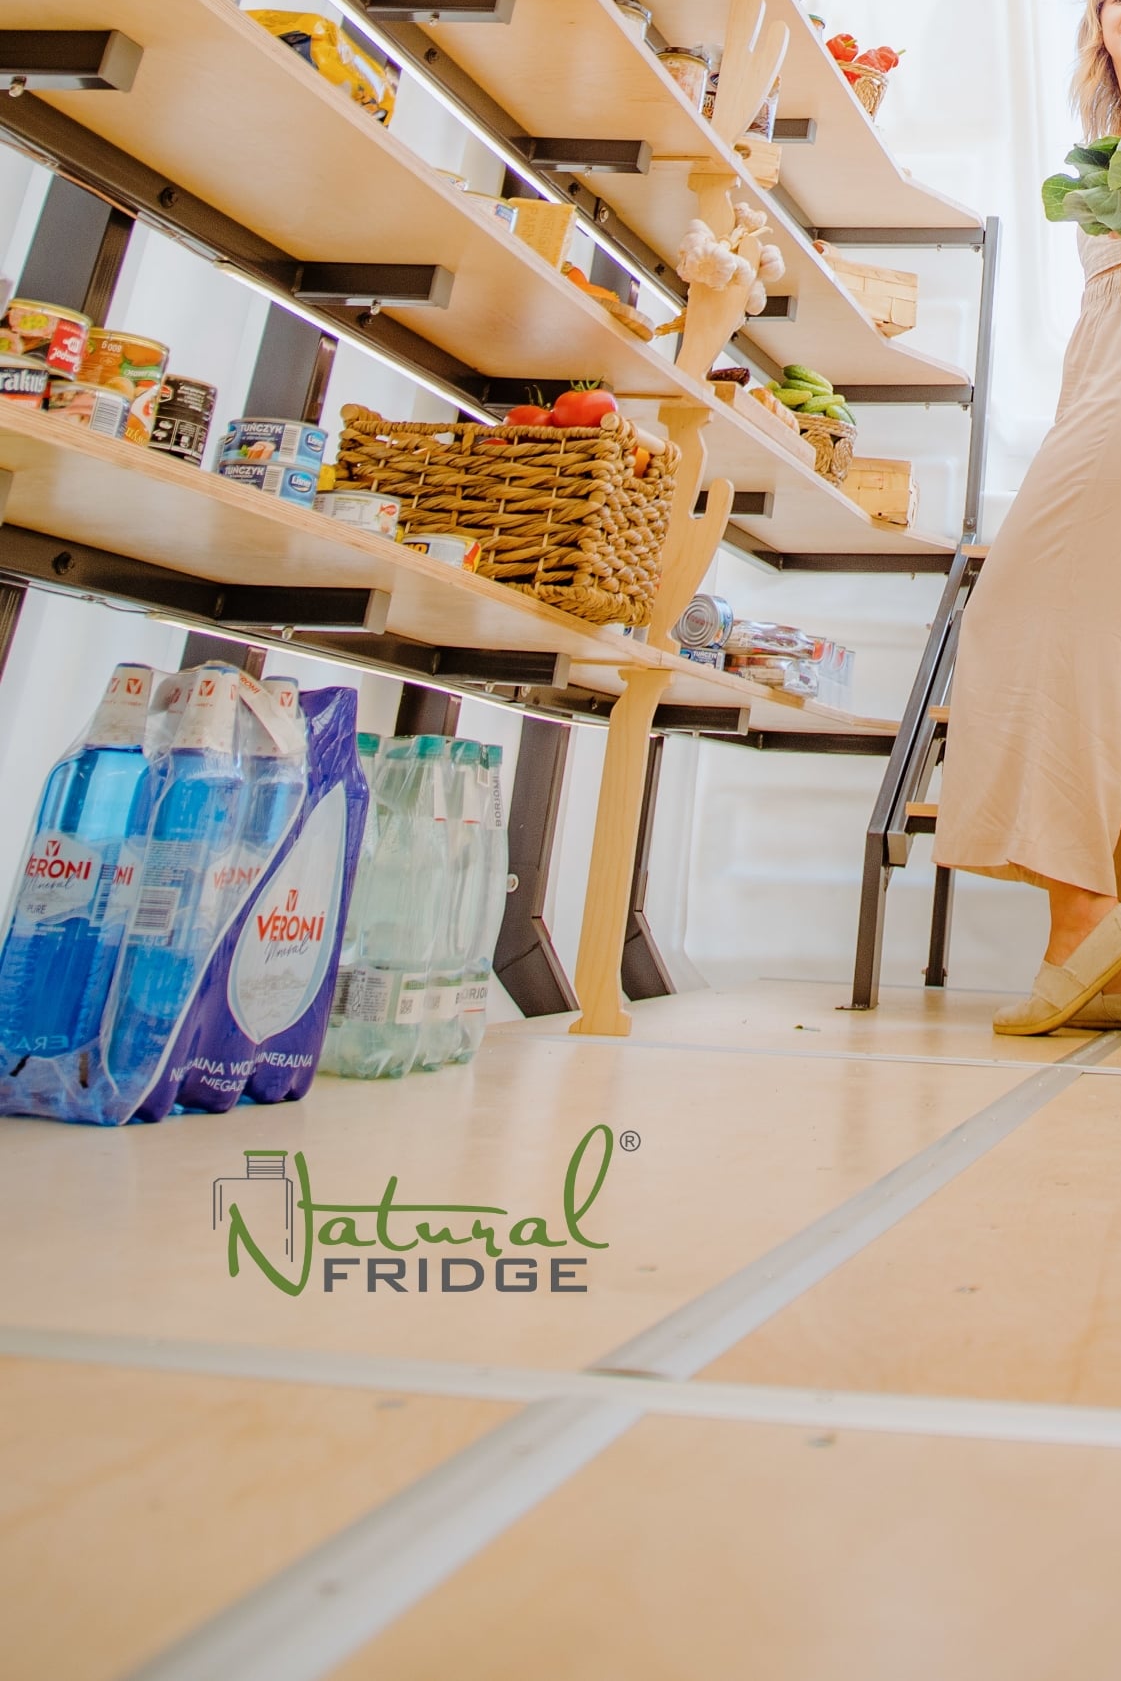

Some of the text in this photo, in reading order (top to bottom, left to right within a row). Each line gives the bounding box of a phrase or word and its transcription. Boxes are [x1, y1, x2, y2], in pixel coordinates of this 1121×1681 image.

[240, 422, 284, 436] TUŃCZYK
[224, 464, 265, 477] TUŃCZYK
[491, 775, 502, 828] BORJOMI
[257, 906, 325, 942] VERONI
